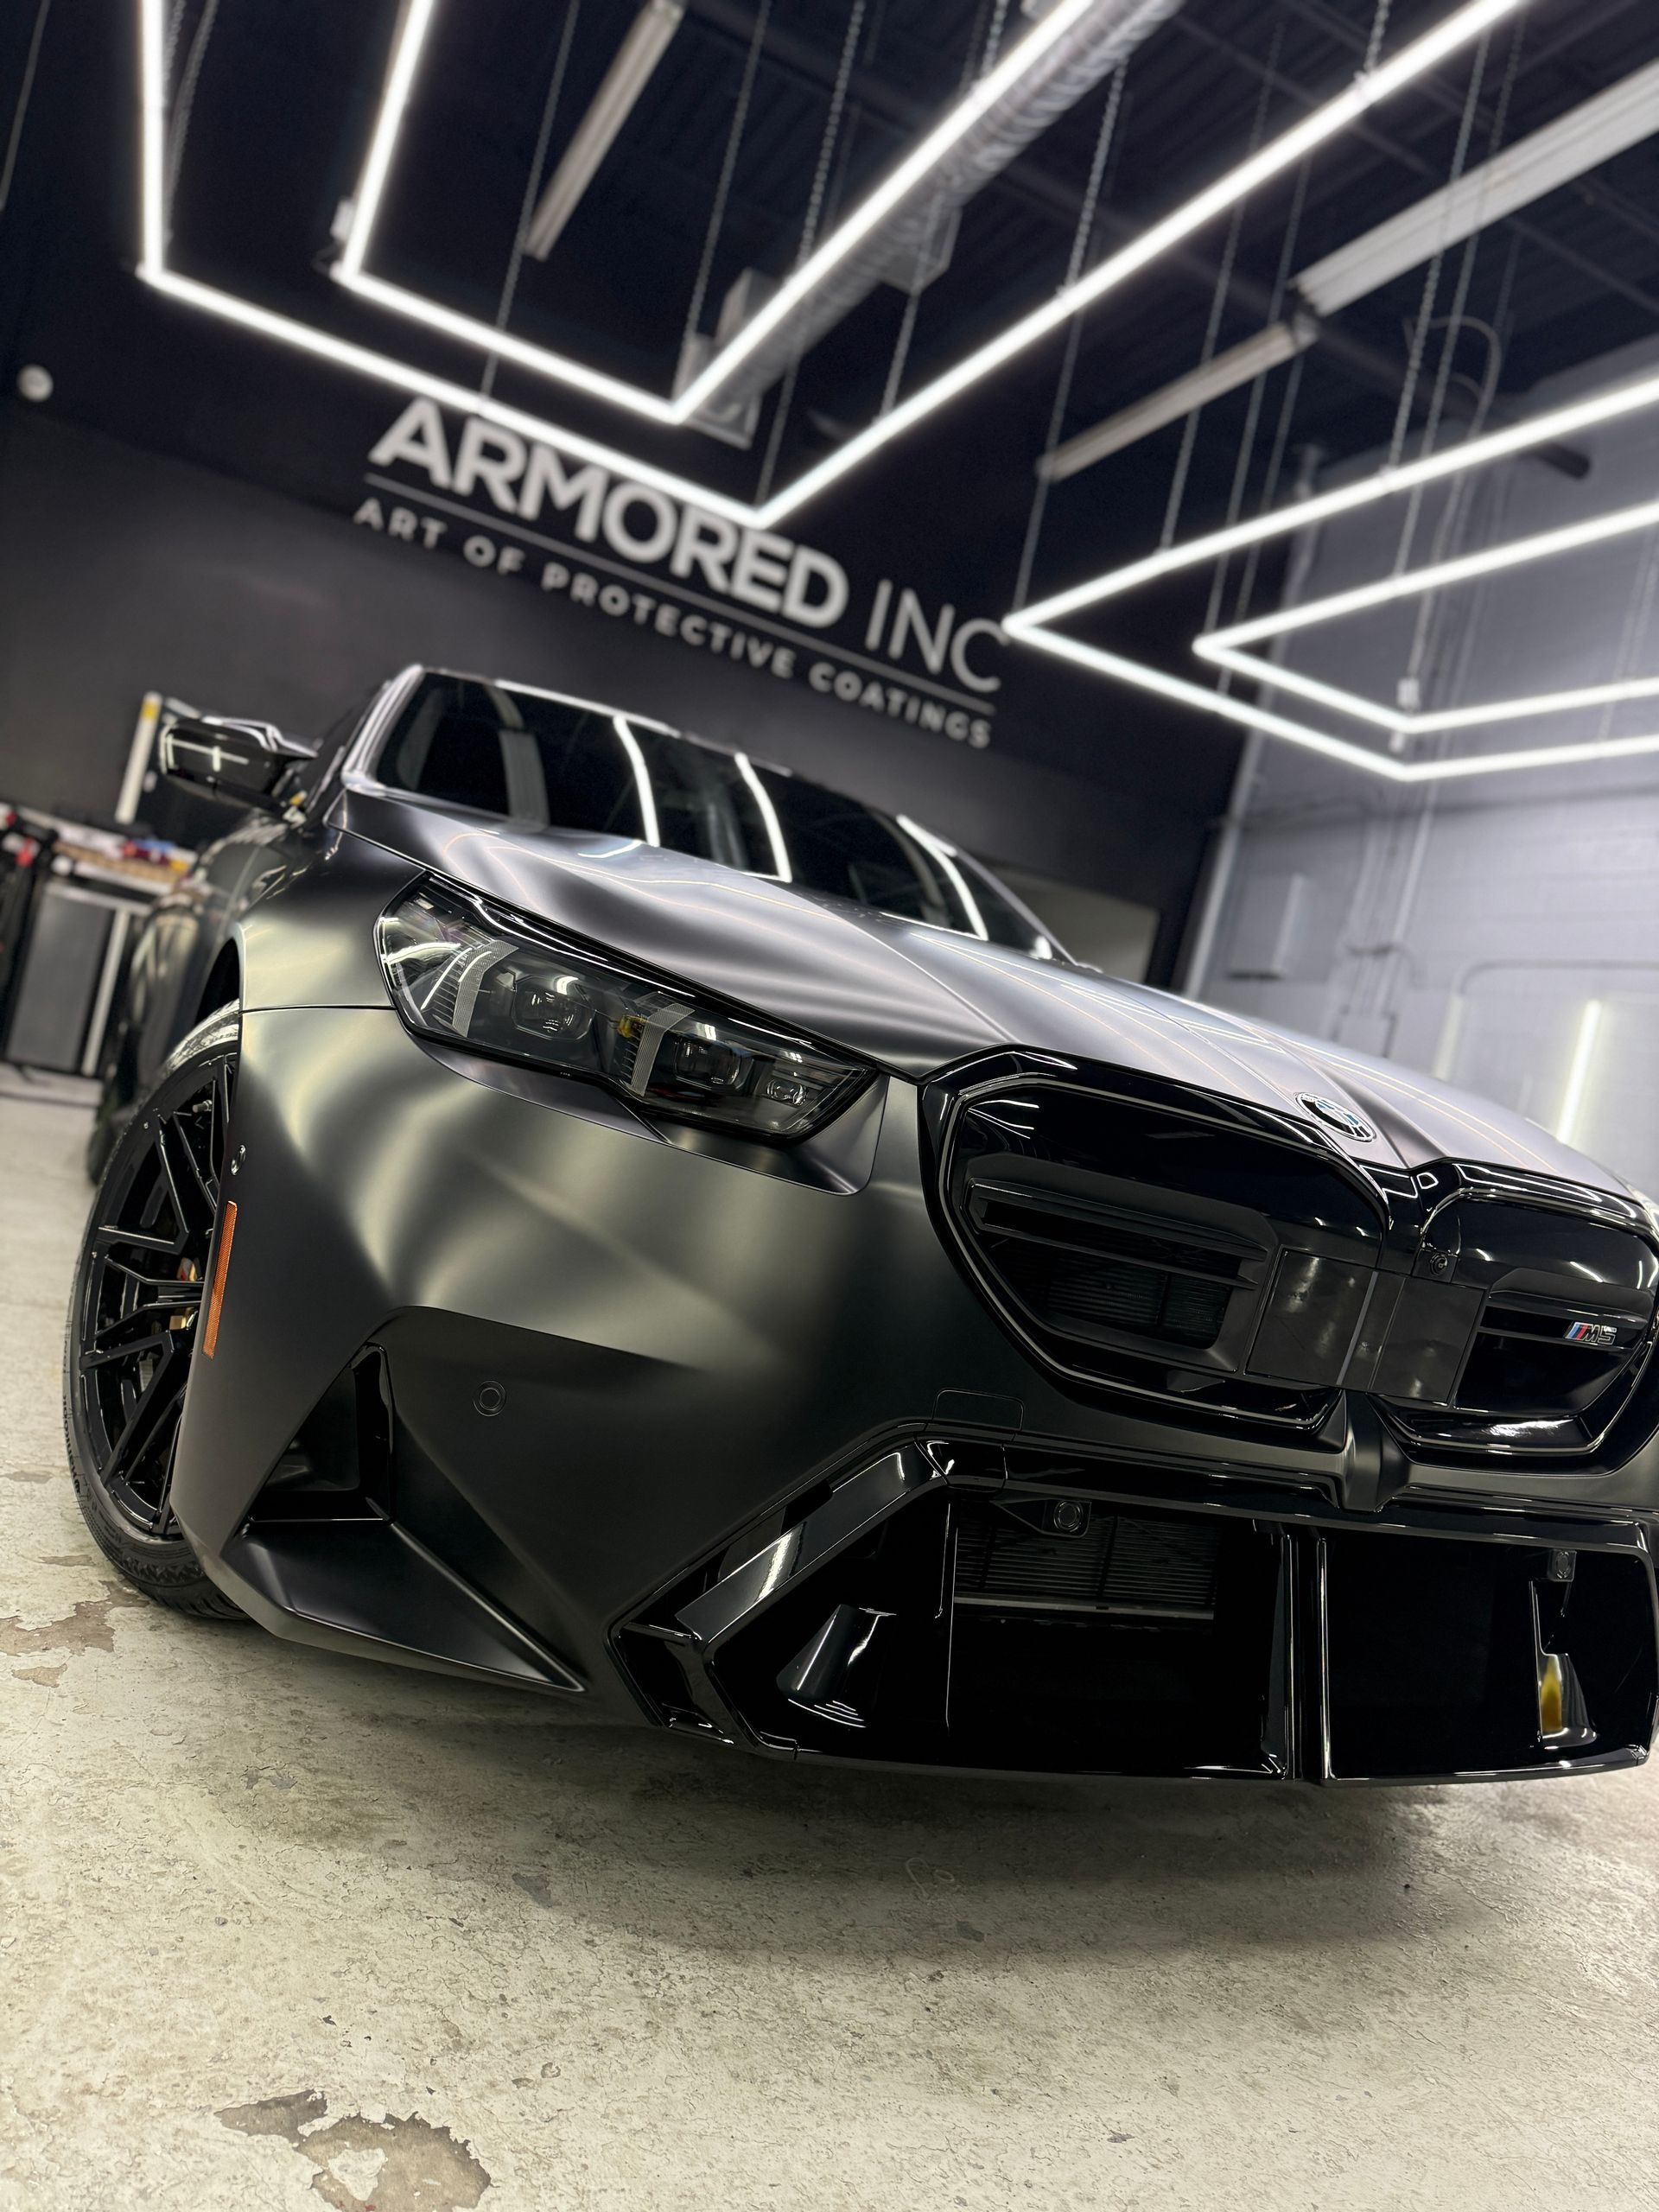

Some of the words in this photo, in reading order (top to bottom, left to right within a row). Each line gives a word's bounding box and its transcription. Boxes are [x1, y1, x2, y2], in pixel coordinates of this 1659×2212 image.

[354, 497, 448, 550] ART
[463, 536, 526, 575] OF
[540, 563, 795, 680] PROTECTIVE
[808, 659, 991, 749] COATINGS
[370, 398, 850, 628] ARMORED
[867, 579, 1009, 693] INC
[1580, 1322, 1618, 1345] M5
